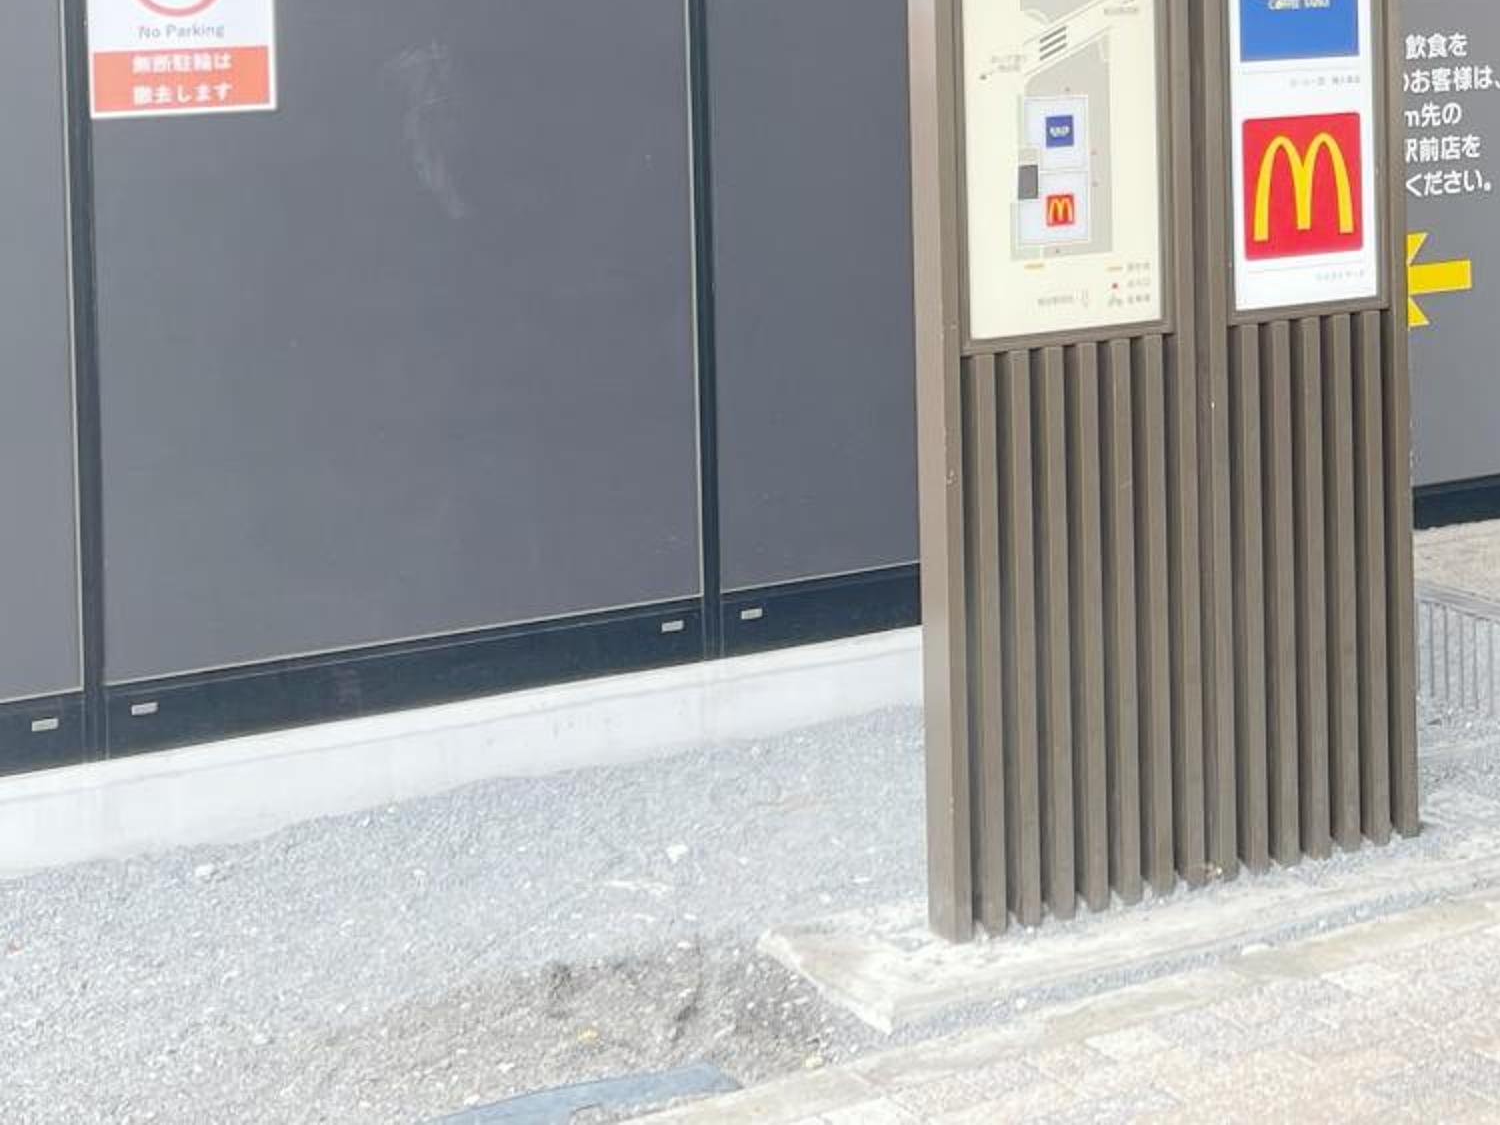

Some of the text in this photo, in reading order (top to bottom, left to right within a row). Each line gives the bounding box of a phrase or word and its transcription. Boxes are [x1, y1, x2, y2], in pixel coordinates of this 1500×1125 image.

[138, 24, 225, 39] No Parking
[1405, 33, 1468, 59] 飲食を
[1405, 169, 1493, 197] ください。
